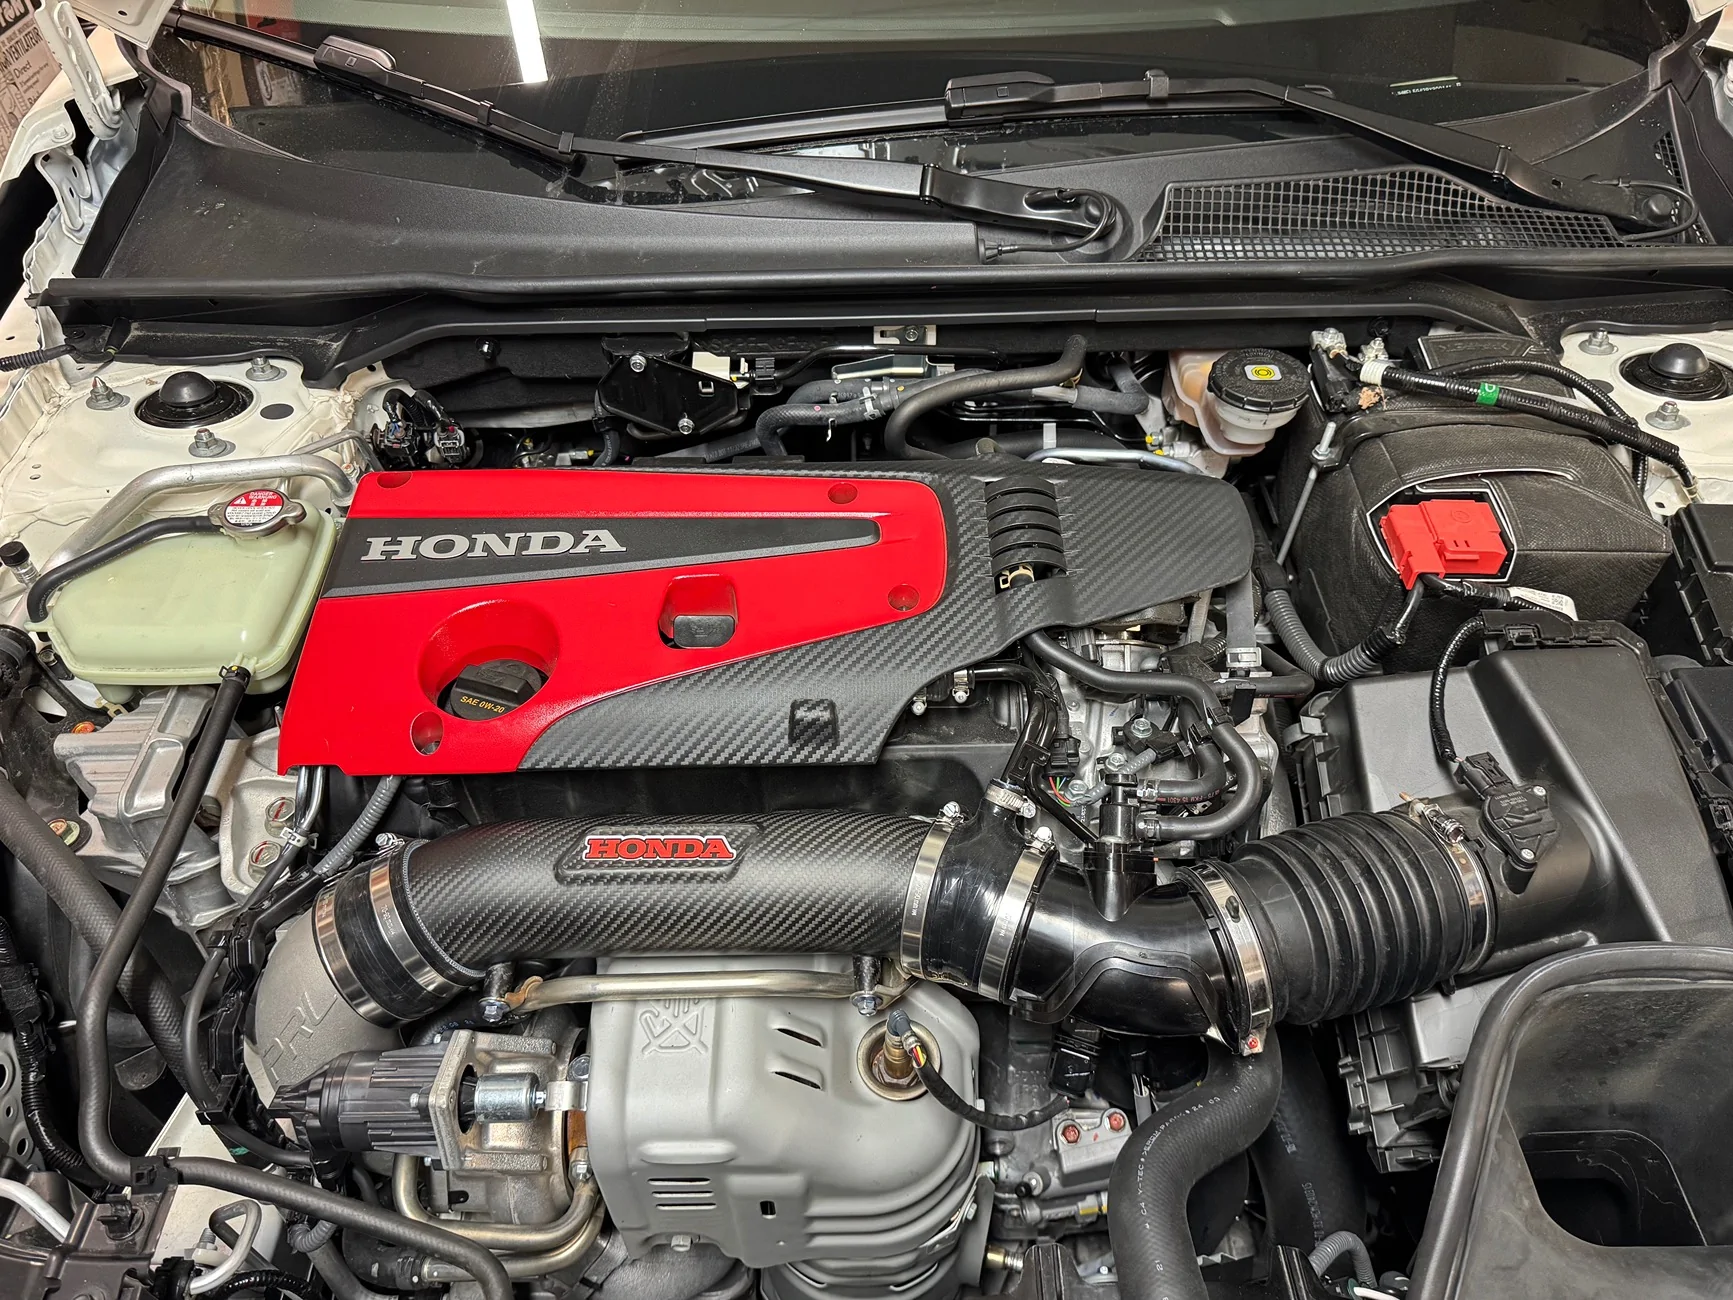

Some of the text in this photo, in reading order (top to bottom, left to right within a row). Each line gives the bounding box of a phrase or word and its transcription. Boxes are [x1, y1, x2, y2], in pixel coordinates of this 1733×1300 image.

[360, 529, 627, 561] HONDA
[460, 695, 505, 714] SAE 0W-20
[584, 837, 735, 860] HONDA
[260, 986, 339, 1085] PRL
